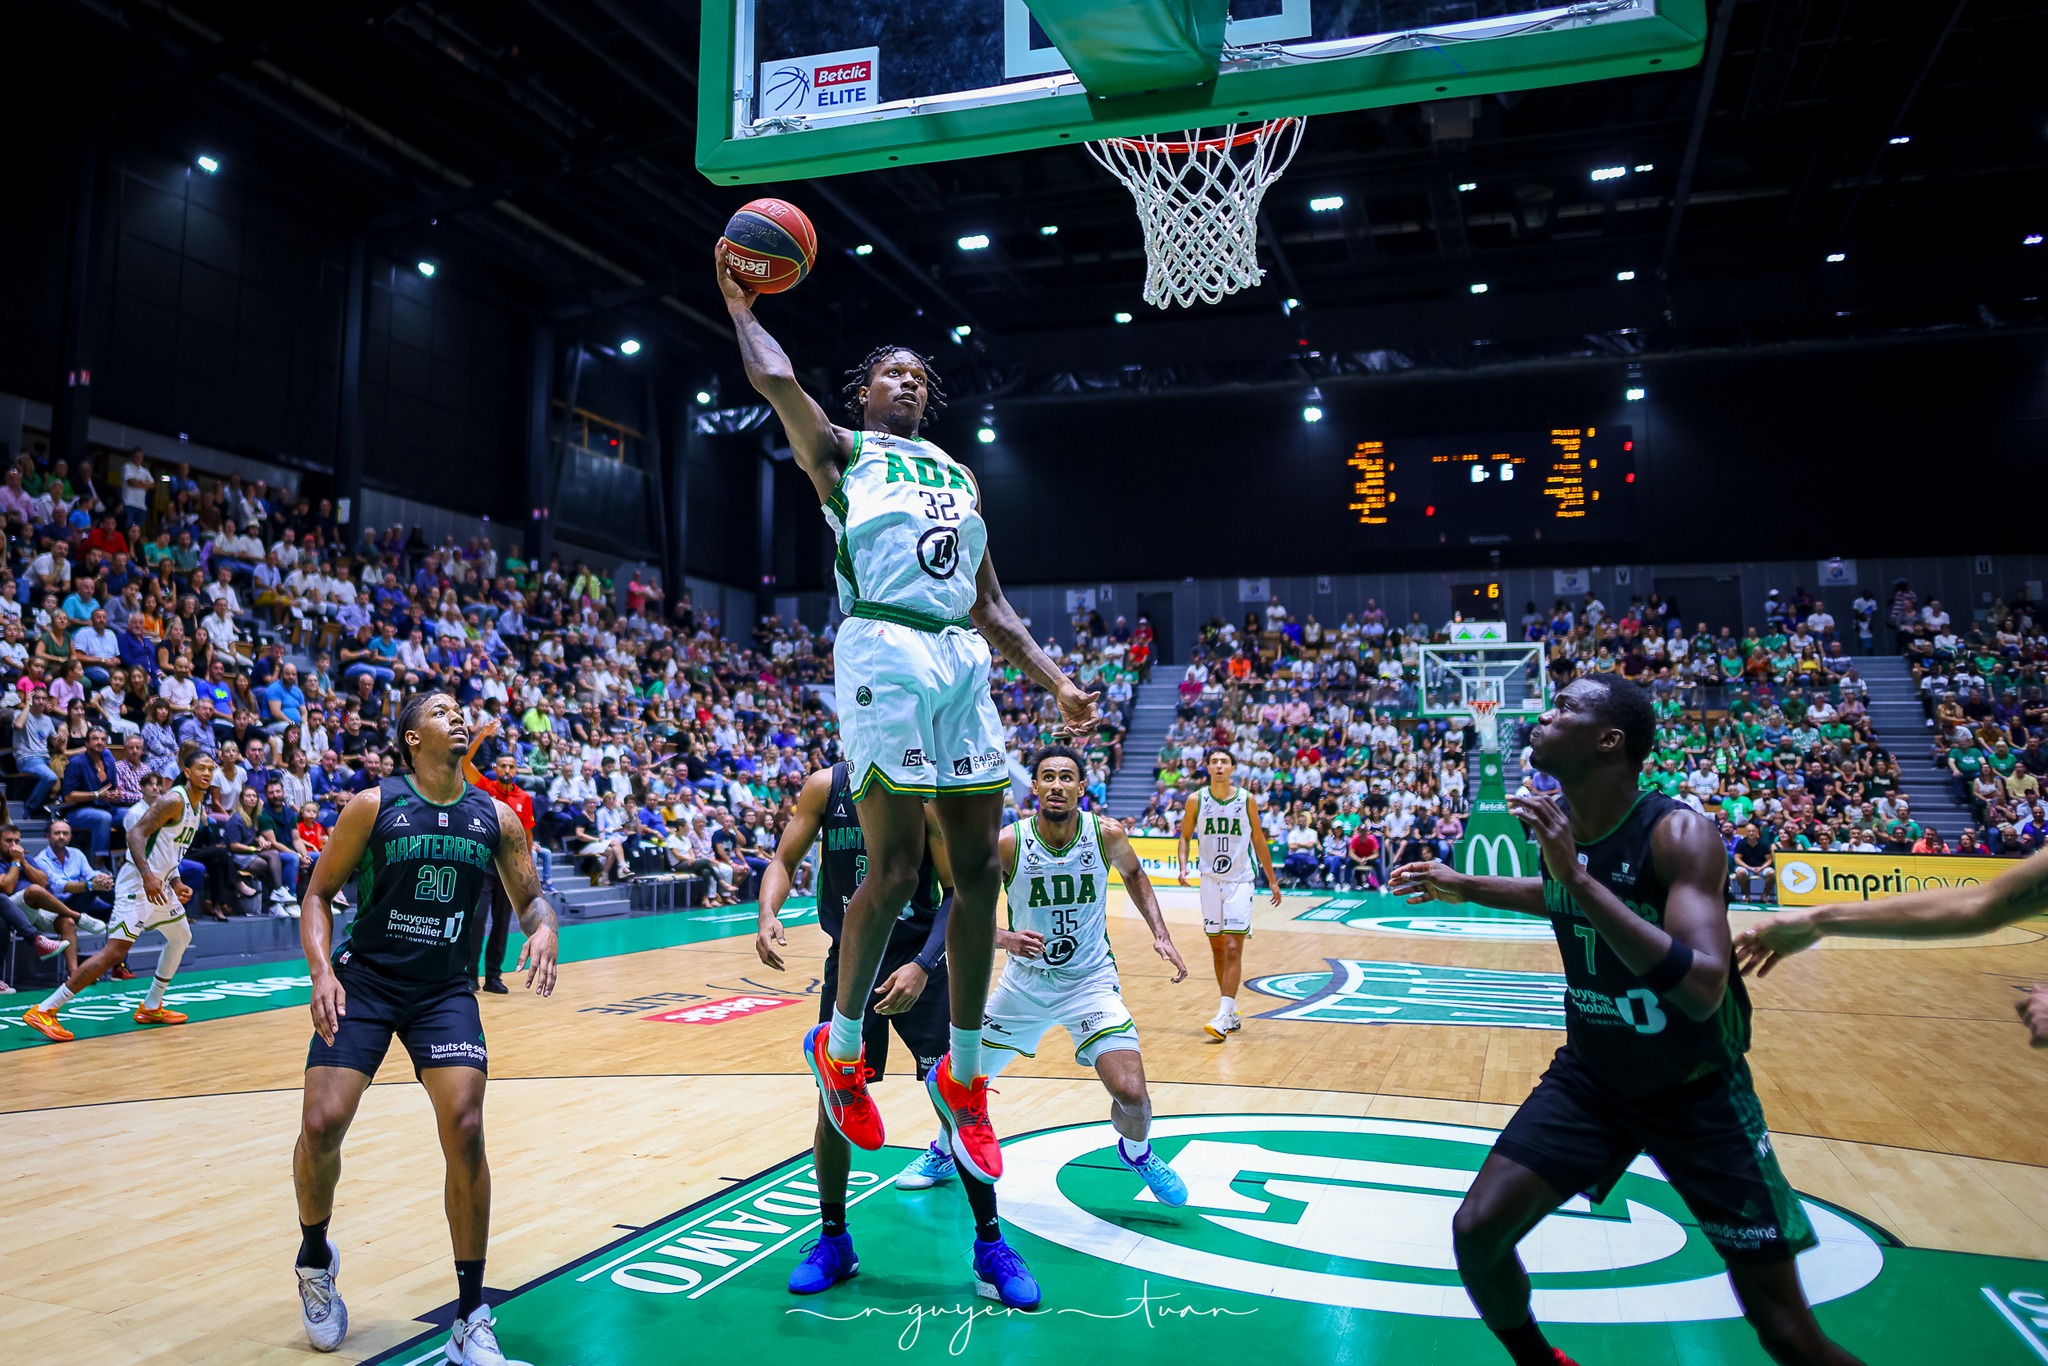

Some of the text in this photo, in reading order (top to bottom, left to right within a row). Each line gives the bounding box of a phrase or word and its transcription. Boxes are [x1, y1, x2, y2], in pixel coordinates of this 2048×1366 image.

[818, 65, 868, 84] Betclic
[818, 88, 867, 107] ÉLITE
[725, 252, 768, 276] Betcli
[884, 451, 975, 498] ADA
[918, 490, 961, 522] 32
[1487, 583, 1499, 599] 6
[173, 826, 195, 845] AD
[1204, 817, 1243, 836] ADA
[1216, 836, 1229, 853] 10
[414, 864, 458, 904] 20
[1028, 873, 1098, 908] ADA
[387, 919, 443, 938] Immobilier
[390, 909, 441, 926] Bouygues
[1051, 908, 1079, 936] 35
[1573, 924, 1597, 975] 7
[577, 992, 712, 1016] ÉLITE
[664, 997, 783, 1023] Betclic
